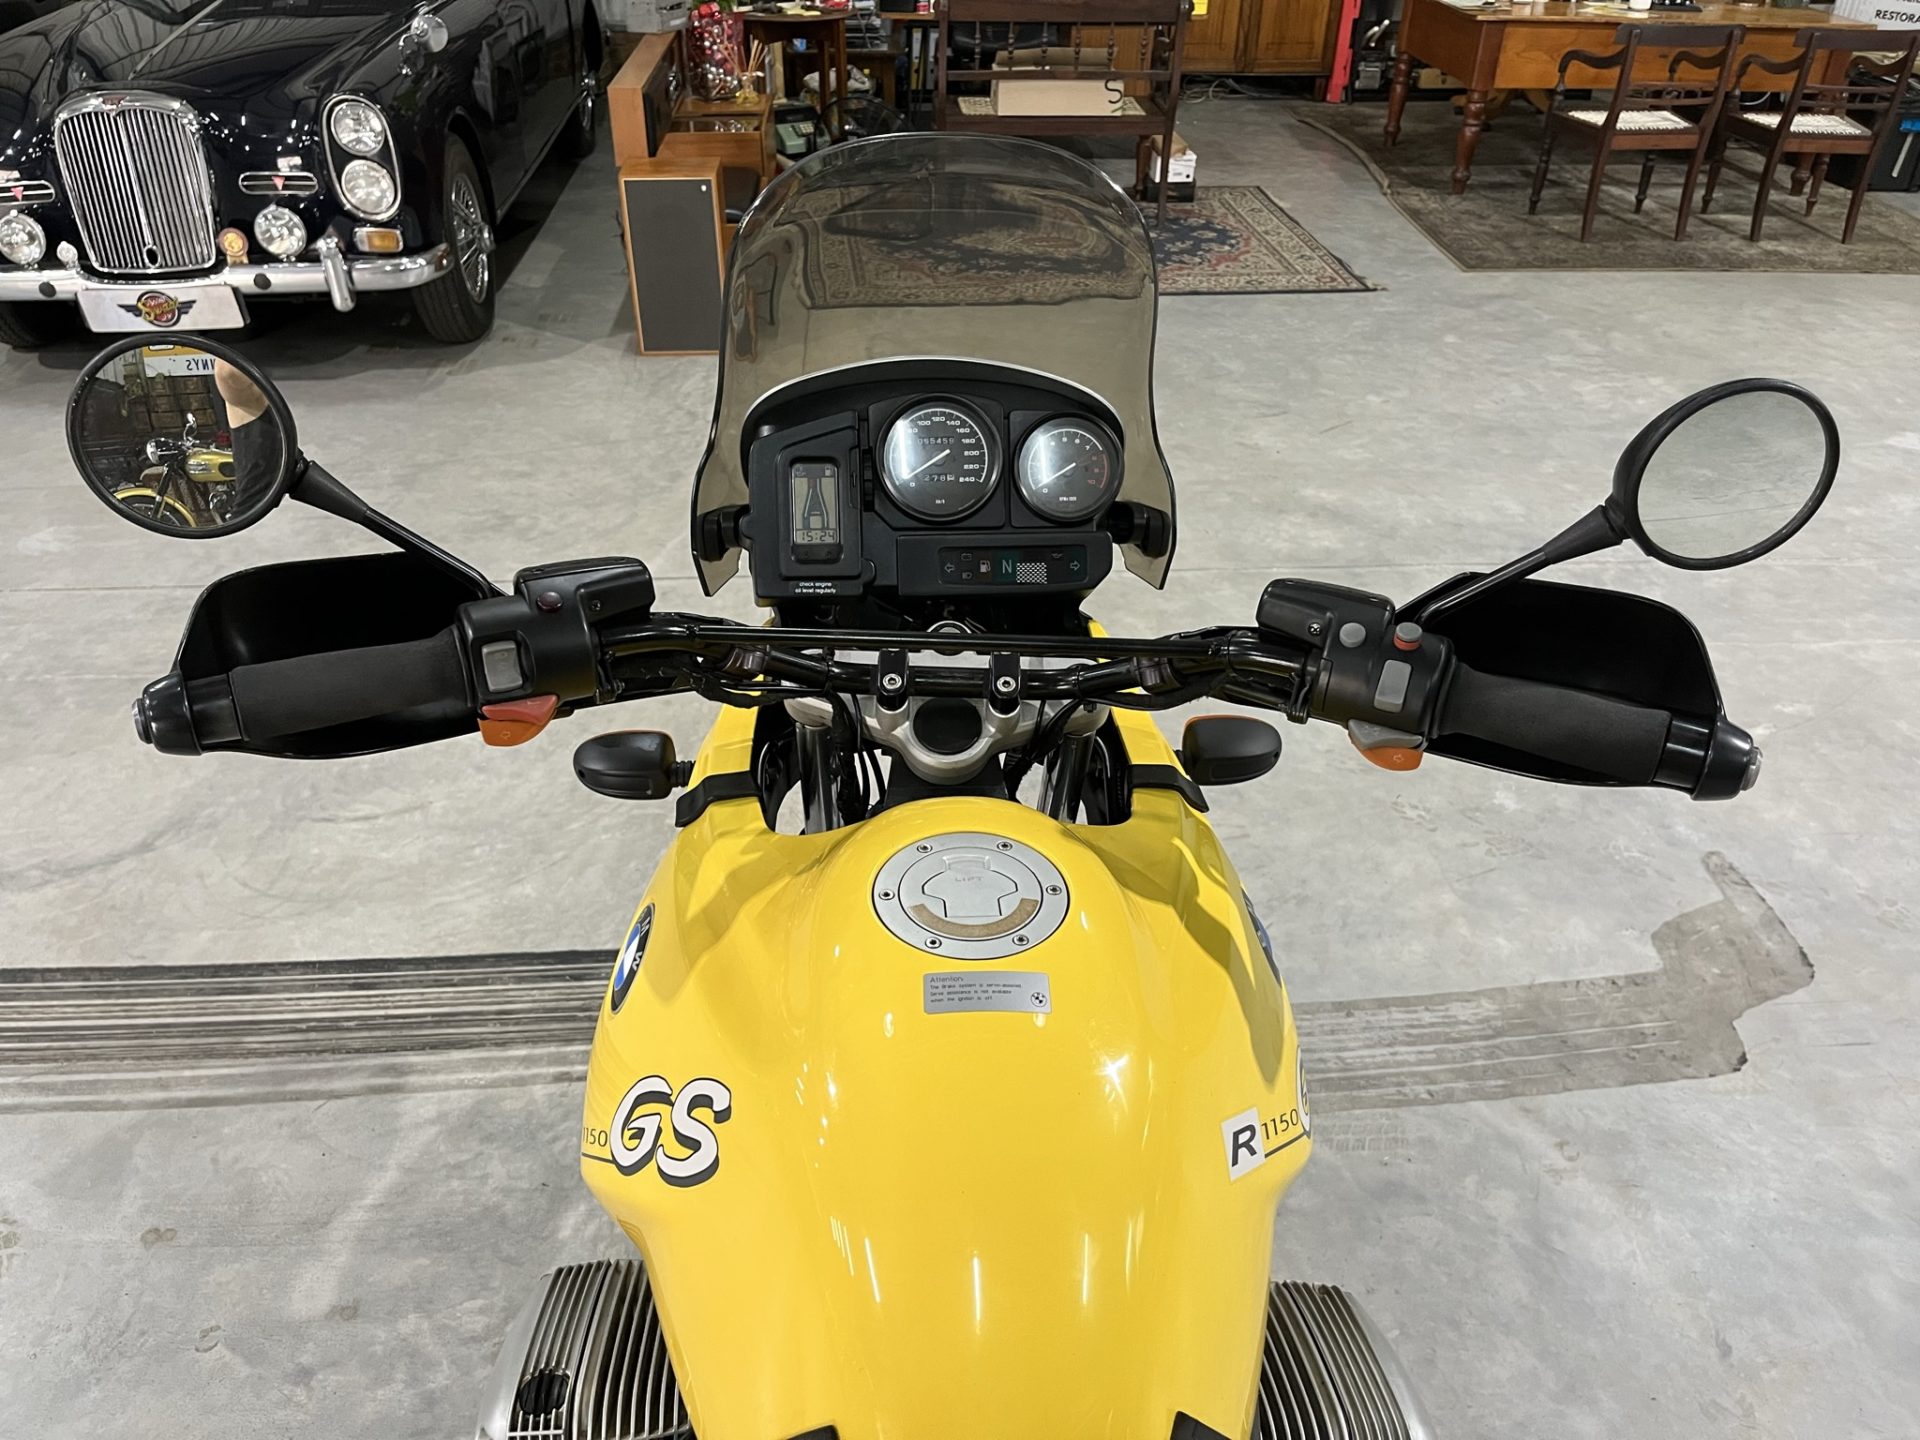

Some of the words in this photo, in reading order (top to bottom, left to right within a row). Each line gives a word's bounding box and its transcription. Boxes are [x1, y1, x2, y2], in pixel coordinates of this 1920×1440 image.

[802, 531, 835, 542] 15:24
[1002, 559, 1012, 574] N
[610, 1075, 732, 1188] GS
[1231, 1123, 1257, 1168] R
[1261, 1108, 1299, 1140] 1150
